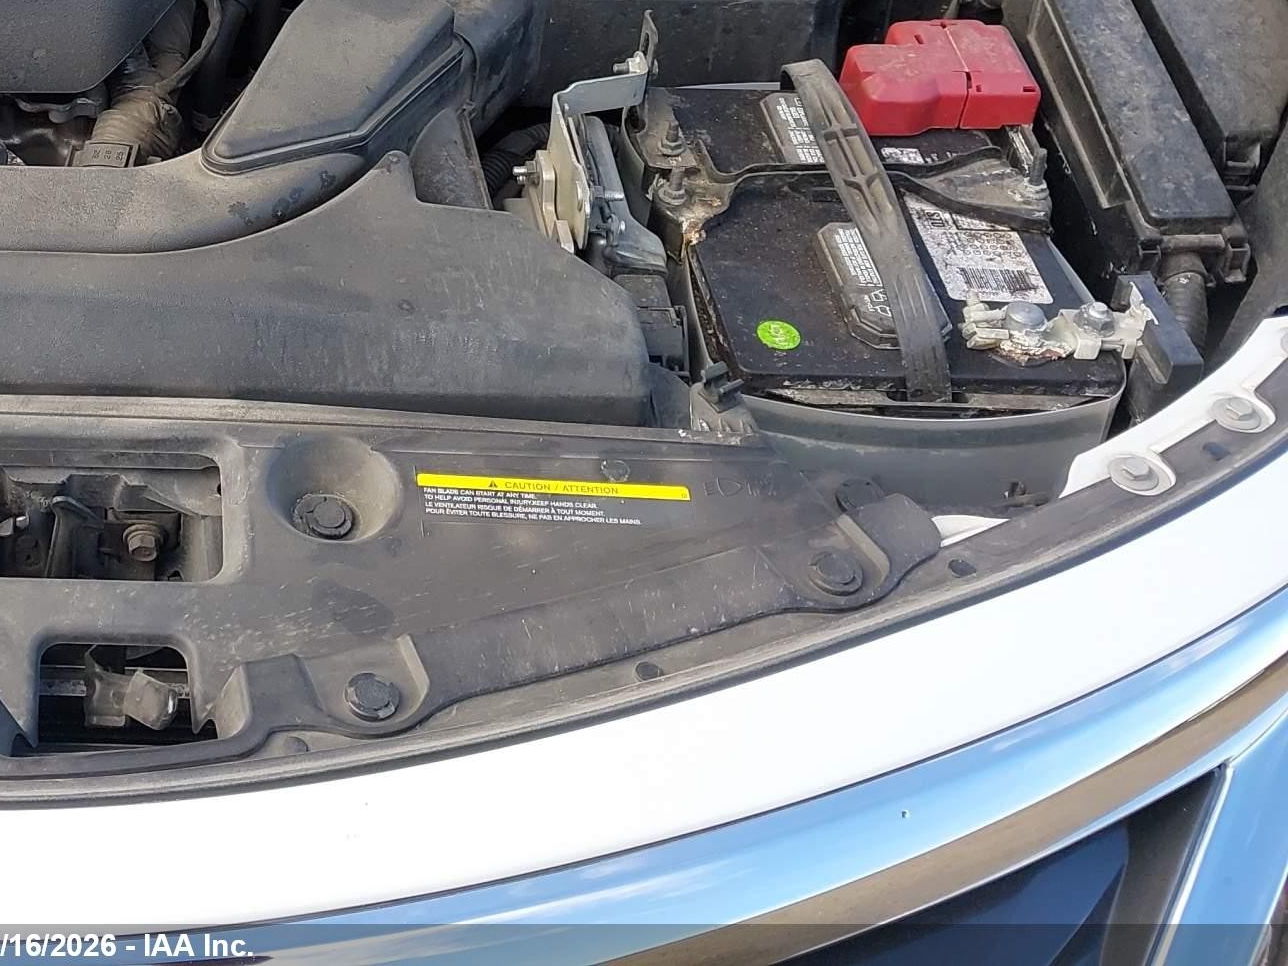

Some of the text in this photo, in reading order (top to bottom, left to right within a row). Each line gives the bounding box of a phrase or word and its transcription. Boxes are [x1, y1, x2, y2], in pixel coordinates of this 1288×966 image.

[505, 481, 551, 491] CAUTION
[562, 484, 618, 494] ATTENTION
[434, 502, 476, 510] VENTILATEUR
[477, 504, 502, 512] RISQUE
[574, 509, 606, 517] MOMENT.
[473, 496, 508, 504] PERSONAL
[574, 501, 598, 509] CLEAR.
[470, 510, 491, 518] TOUTE
[491, 511, 527, 520] BLESSURE,
[563, 515, 605, 523] APPROCHER
[619, 517, 642, 525] MAINS.
